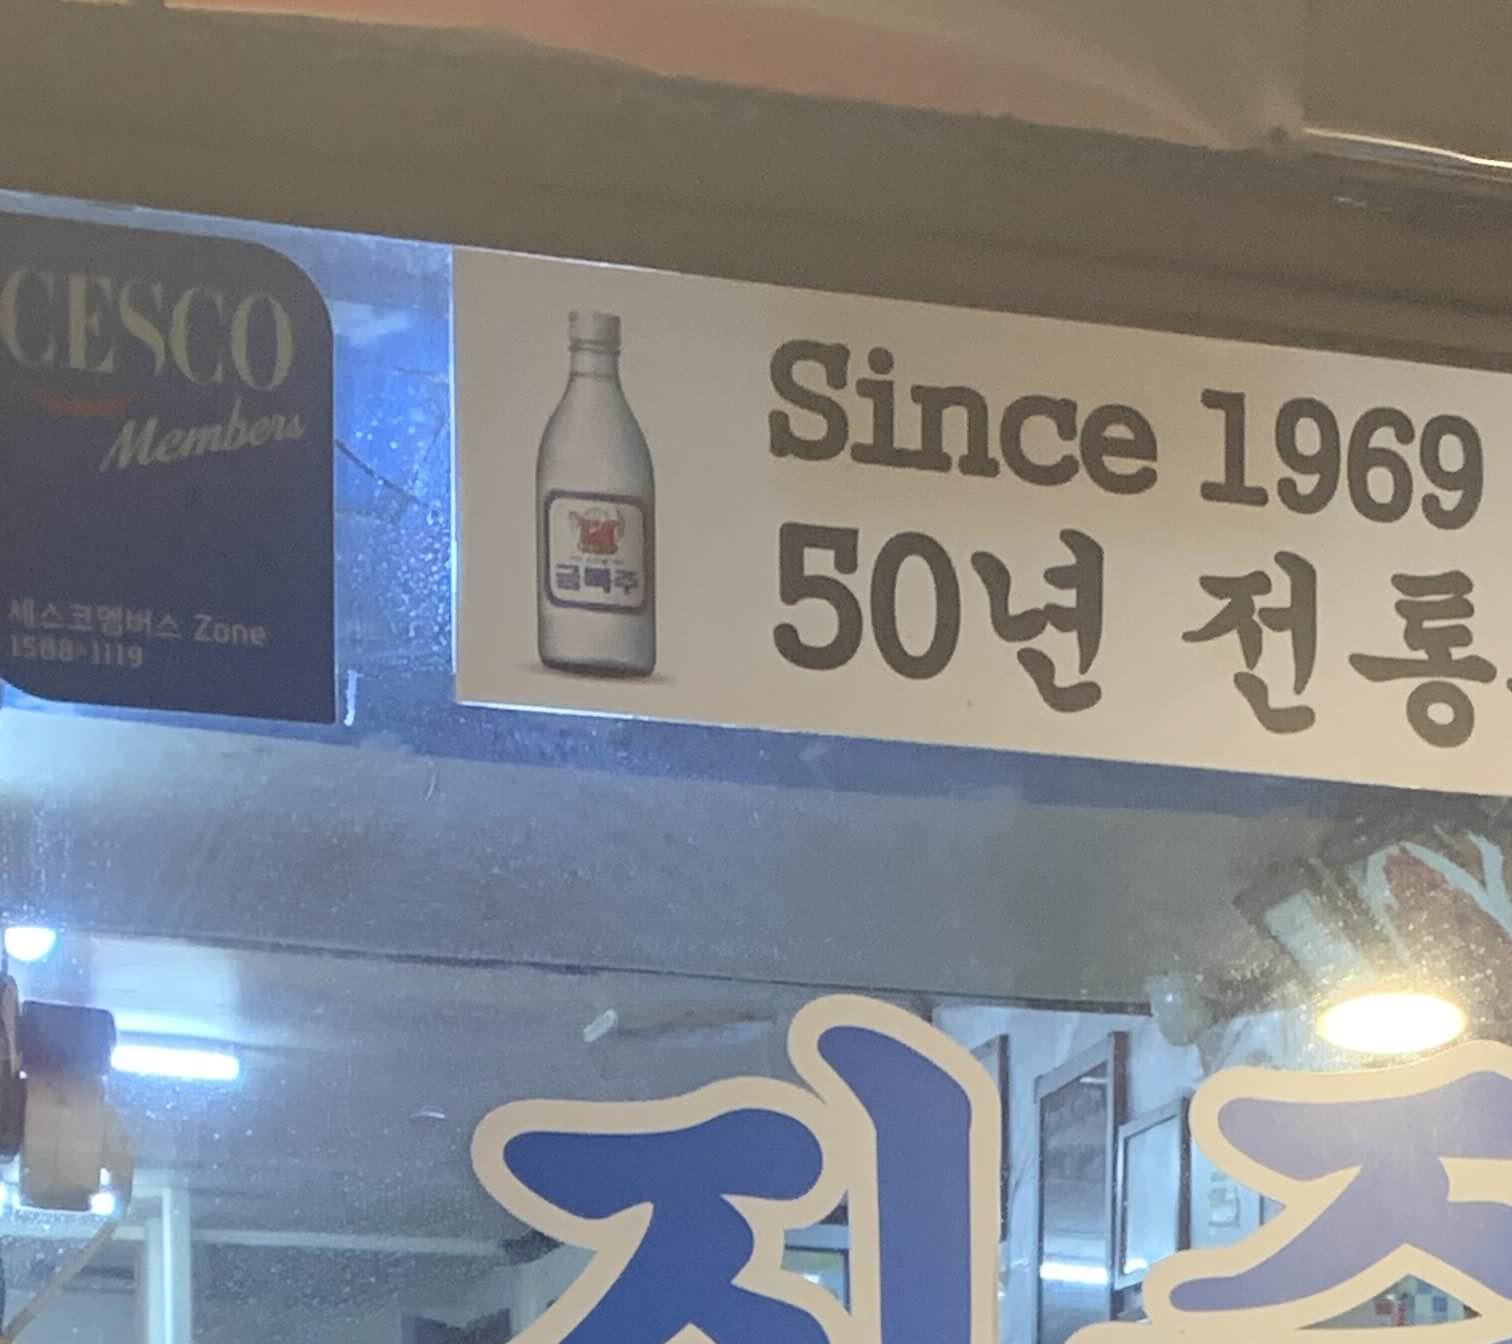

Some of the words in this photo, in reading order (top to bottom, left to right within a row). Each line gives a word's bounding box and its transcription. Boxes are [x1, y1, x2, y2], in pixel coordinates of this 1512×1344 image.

[0, 266, 294, 394] CESCO
[100, 399, 306, 472] Members
[767, 338, 1158, 495] Since
[1199, 387, 1484, 531] 1969
[192, 614, 267, 648] Zone
[772, 521, 1105, 713] 50년
